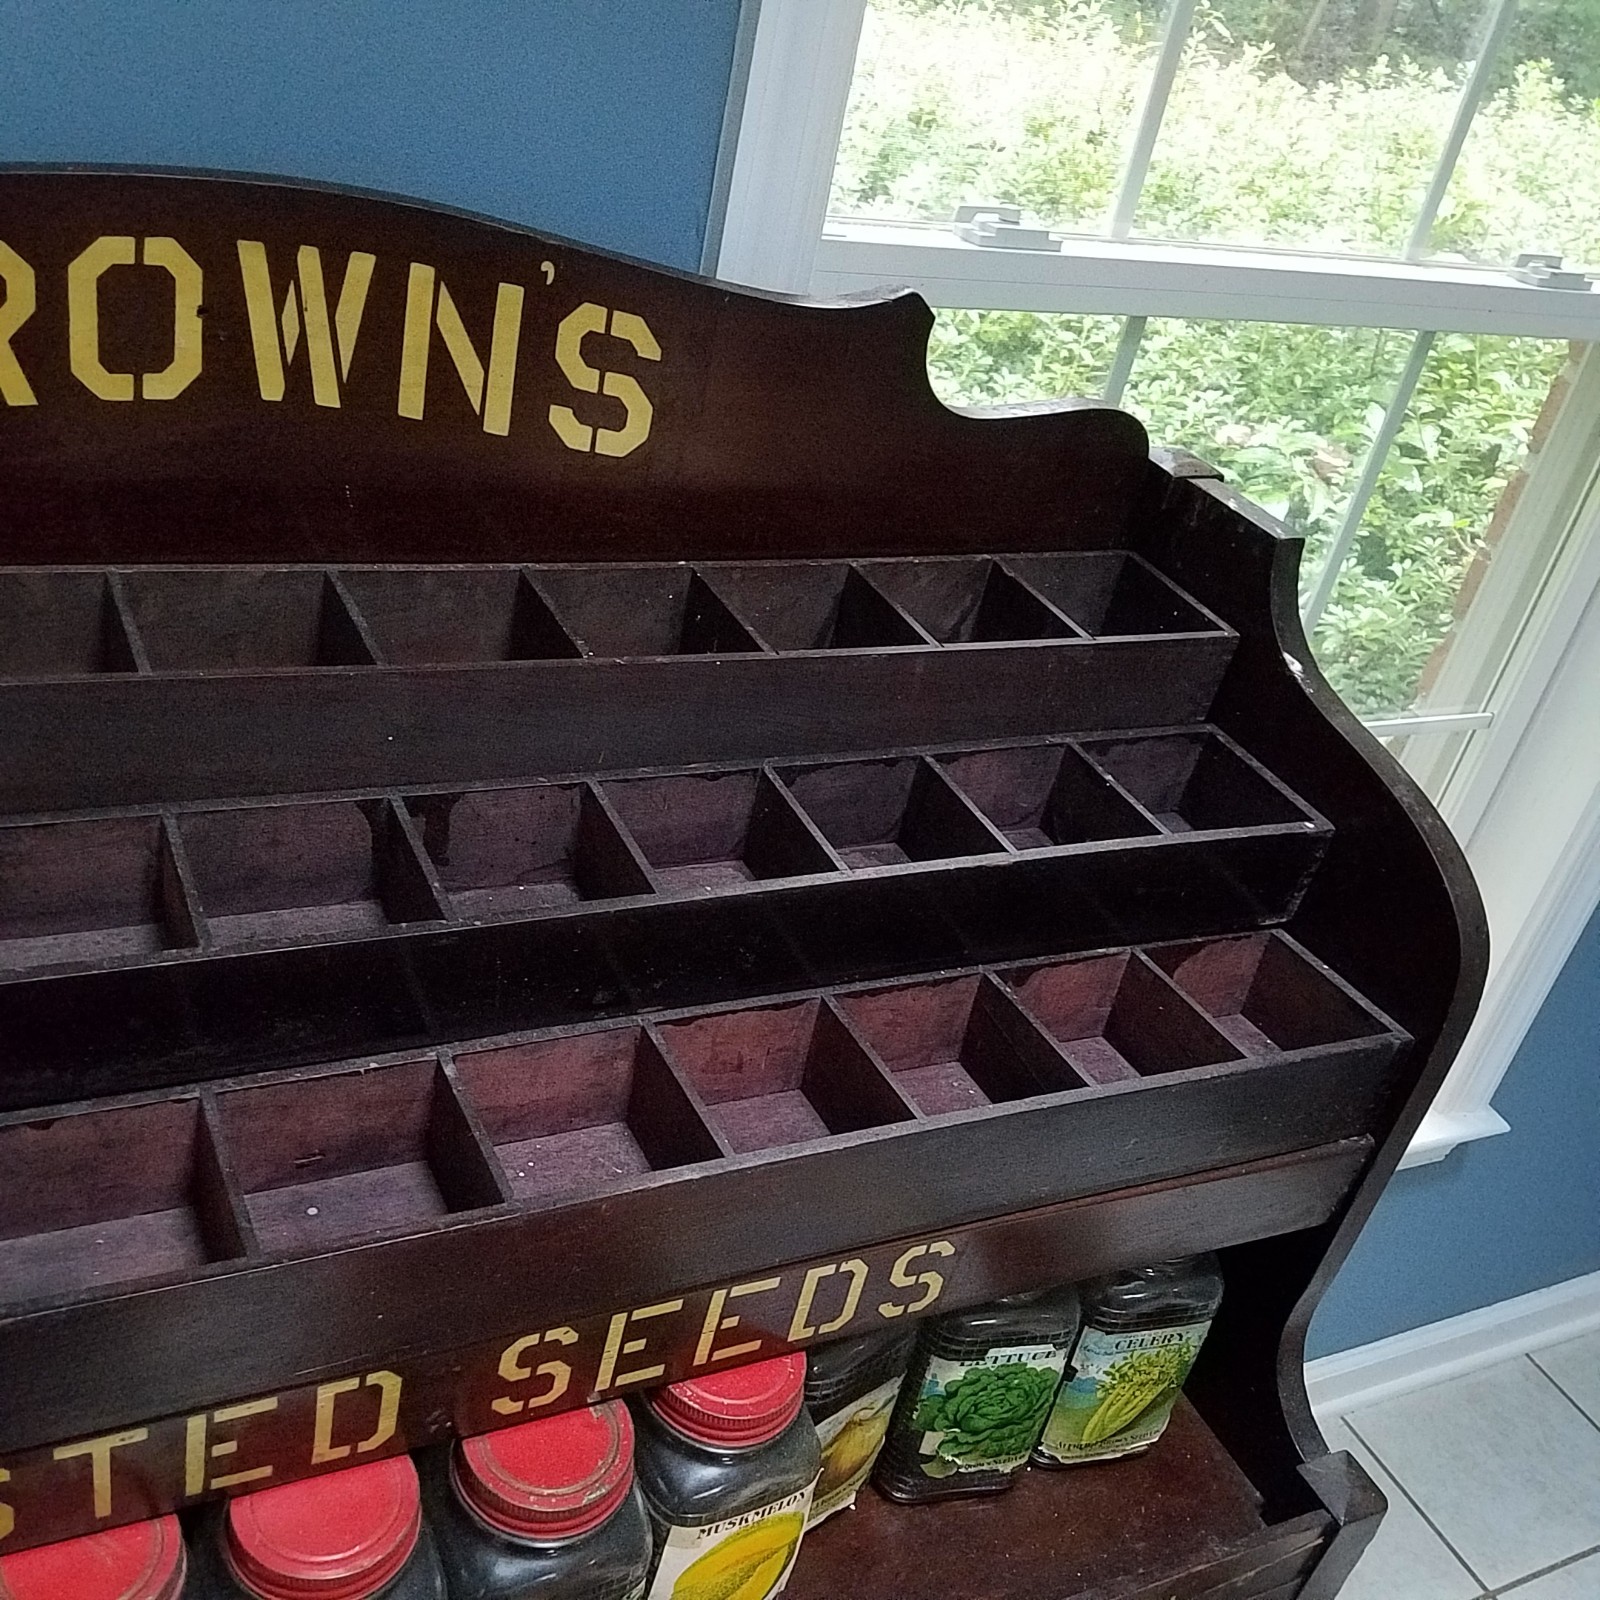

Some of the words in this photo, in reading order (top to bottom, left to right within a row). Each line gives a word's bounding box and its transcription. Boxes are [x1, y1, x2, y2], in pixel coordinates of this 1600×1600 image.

[1114, 1331, 1189, 1351] CELERY
[0, 1369, 403, 1540] TED
[490, 1240, 956, 1416] SEEDS
[696, 1488, 809, 1540] MUSKMELON
